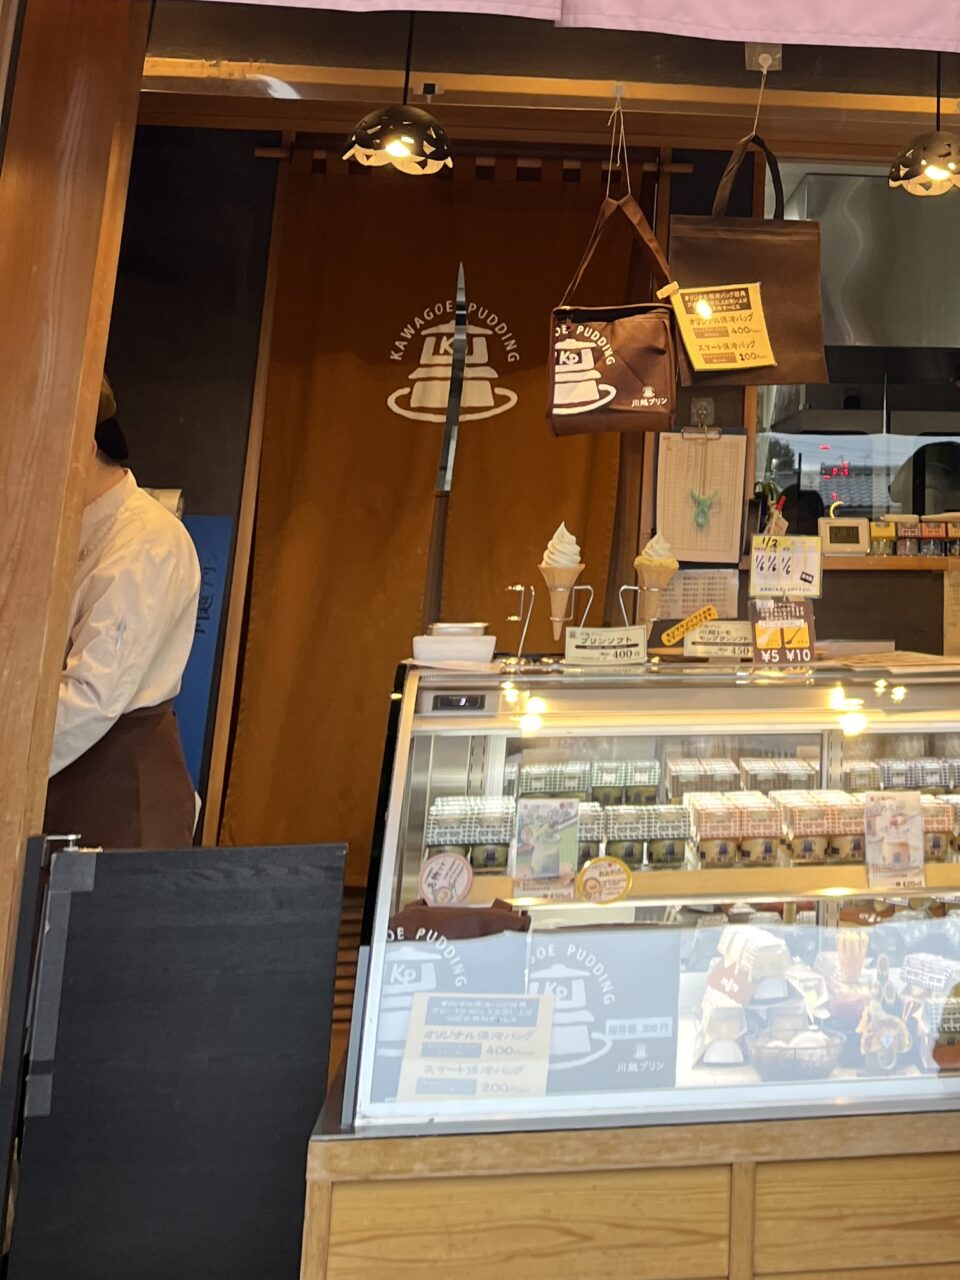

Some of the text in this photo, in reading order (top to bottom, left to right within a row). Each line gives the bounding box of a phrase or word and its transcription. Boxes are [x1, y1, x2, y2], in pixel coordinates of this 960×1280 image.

[390, 300, 520, 362] KAWAGOE PUDDING
[576, 325, 616, 366] PUDDING
[761, 649, 811, 662] ¥5 ¥10
[416, 928, 467, 987] PUDDING
[566, 944, 615, 1005] PUDDING
